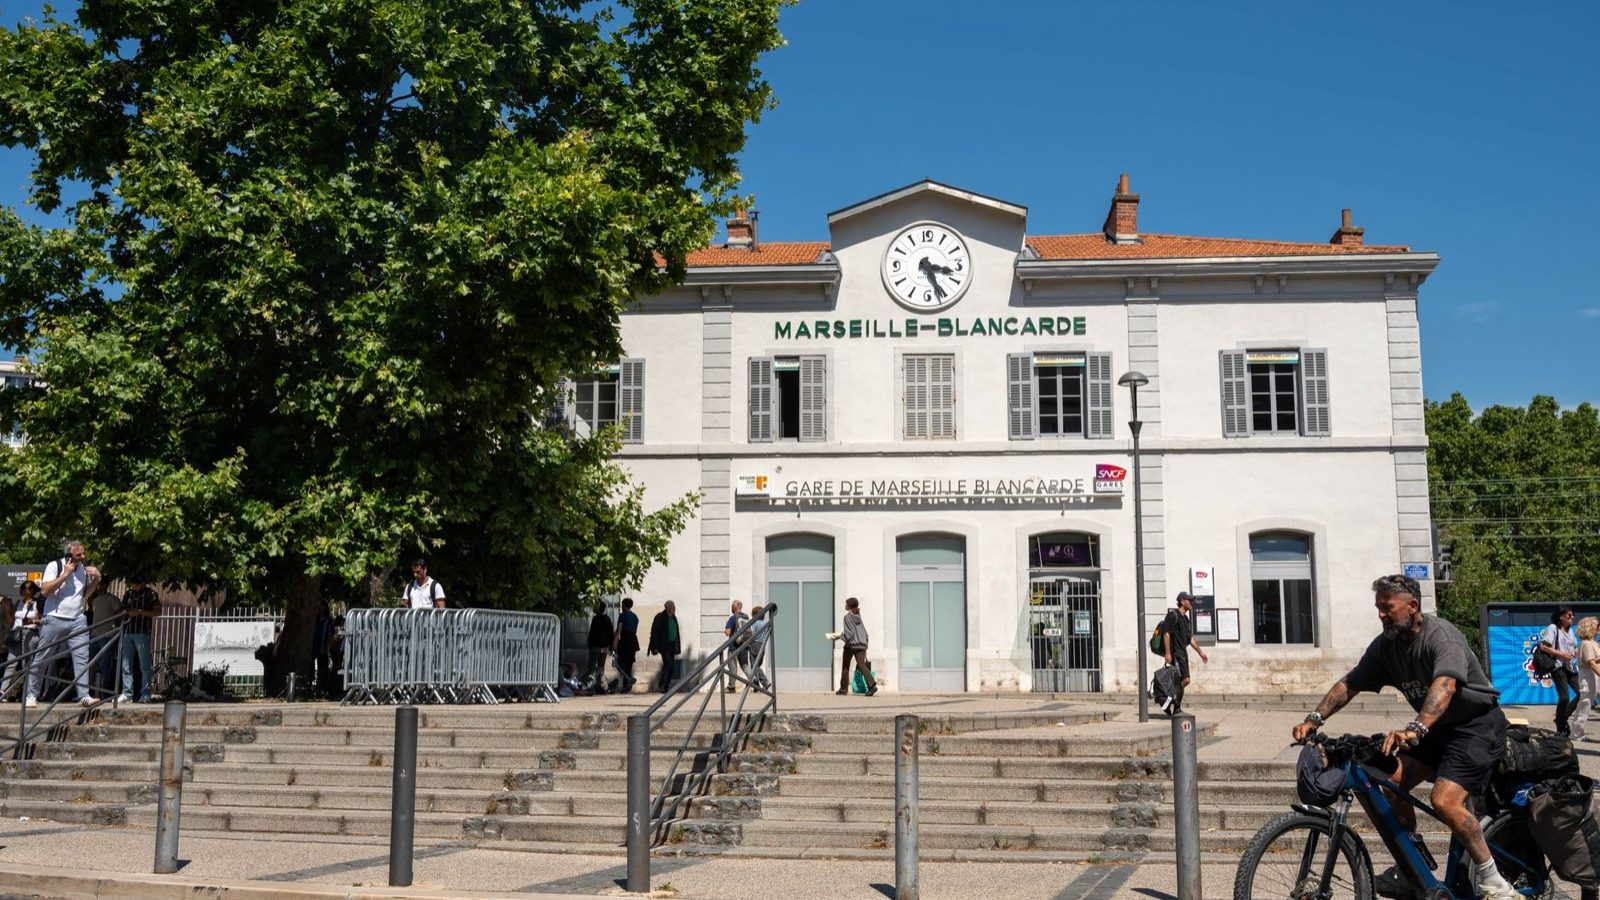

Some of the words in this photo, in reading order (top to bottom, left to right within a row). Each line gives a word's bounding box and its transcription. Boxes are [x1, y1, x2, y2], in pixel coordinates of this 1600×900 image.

[922, 230, 934, 242] 12
[892, 260, 901, 272] 9
[954, 259, 963, 271] 3
[923, 290, 932, 302] 6
[775, 317, 1087, 340] MARSEILLE-BLANCARDE
[1098, 469, 1125, 478] SNCF
[786, 480, 834, 496] GARE
[839, 480, 864, 495] DE
[870, 480, 967, 495] MARSEILLE
[973, 478, 1085, 494] BLANCARDE
